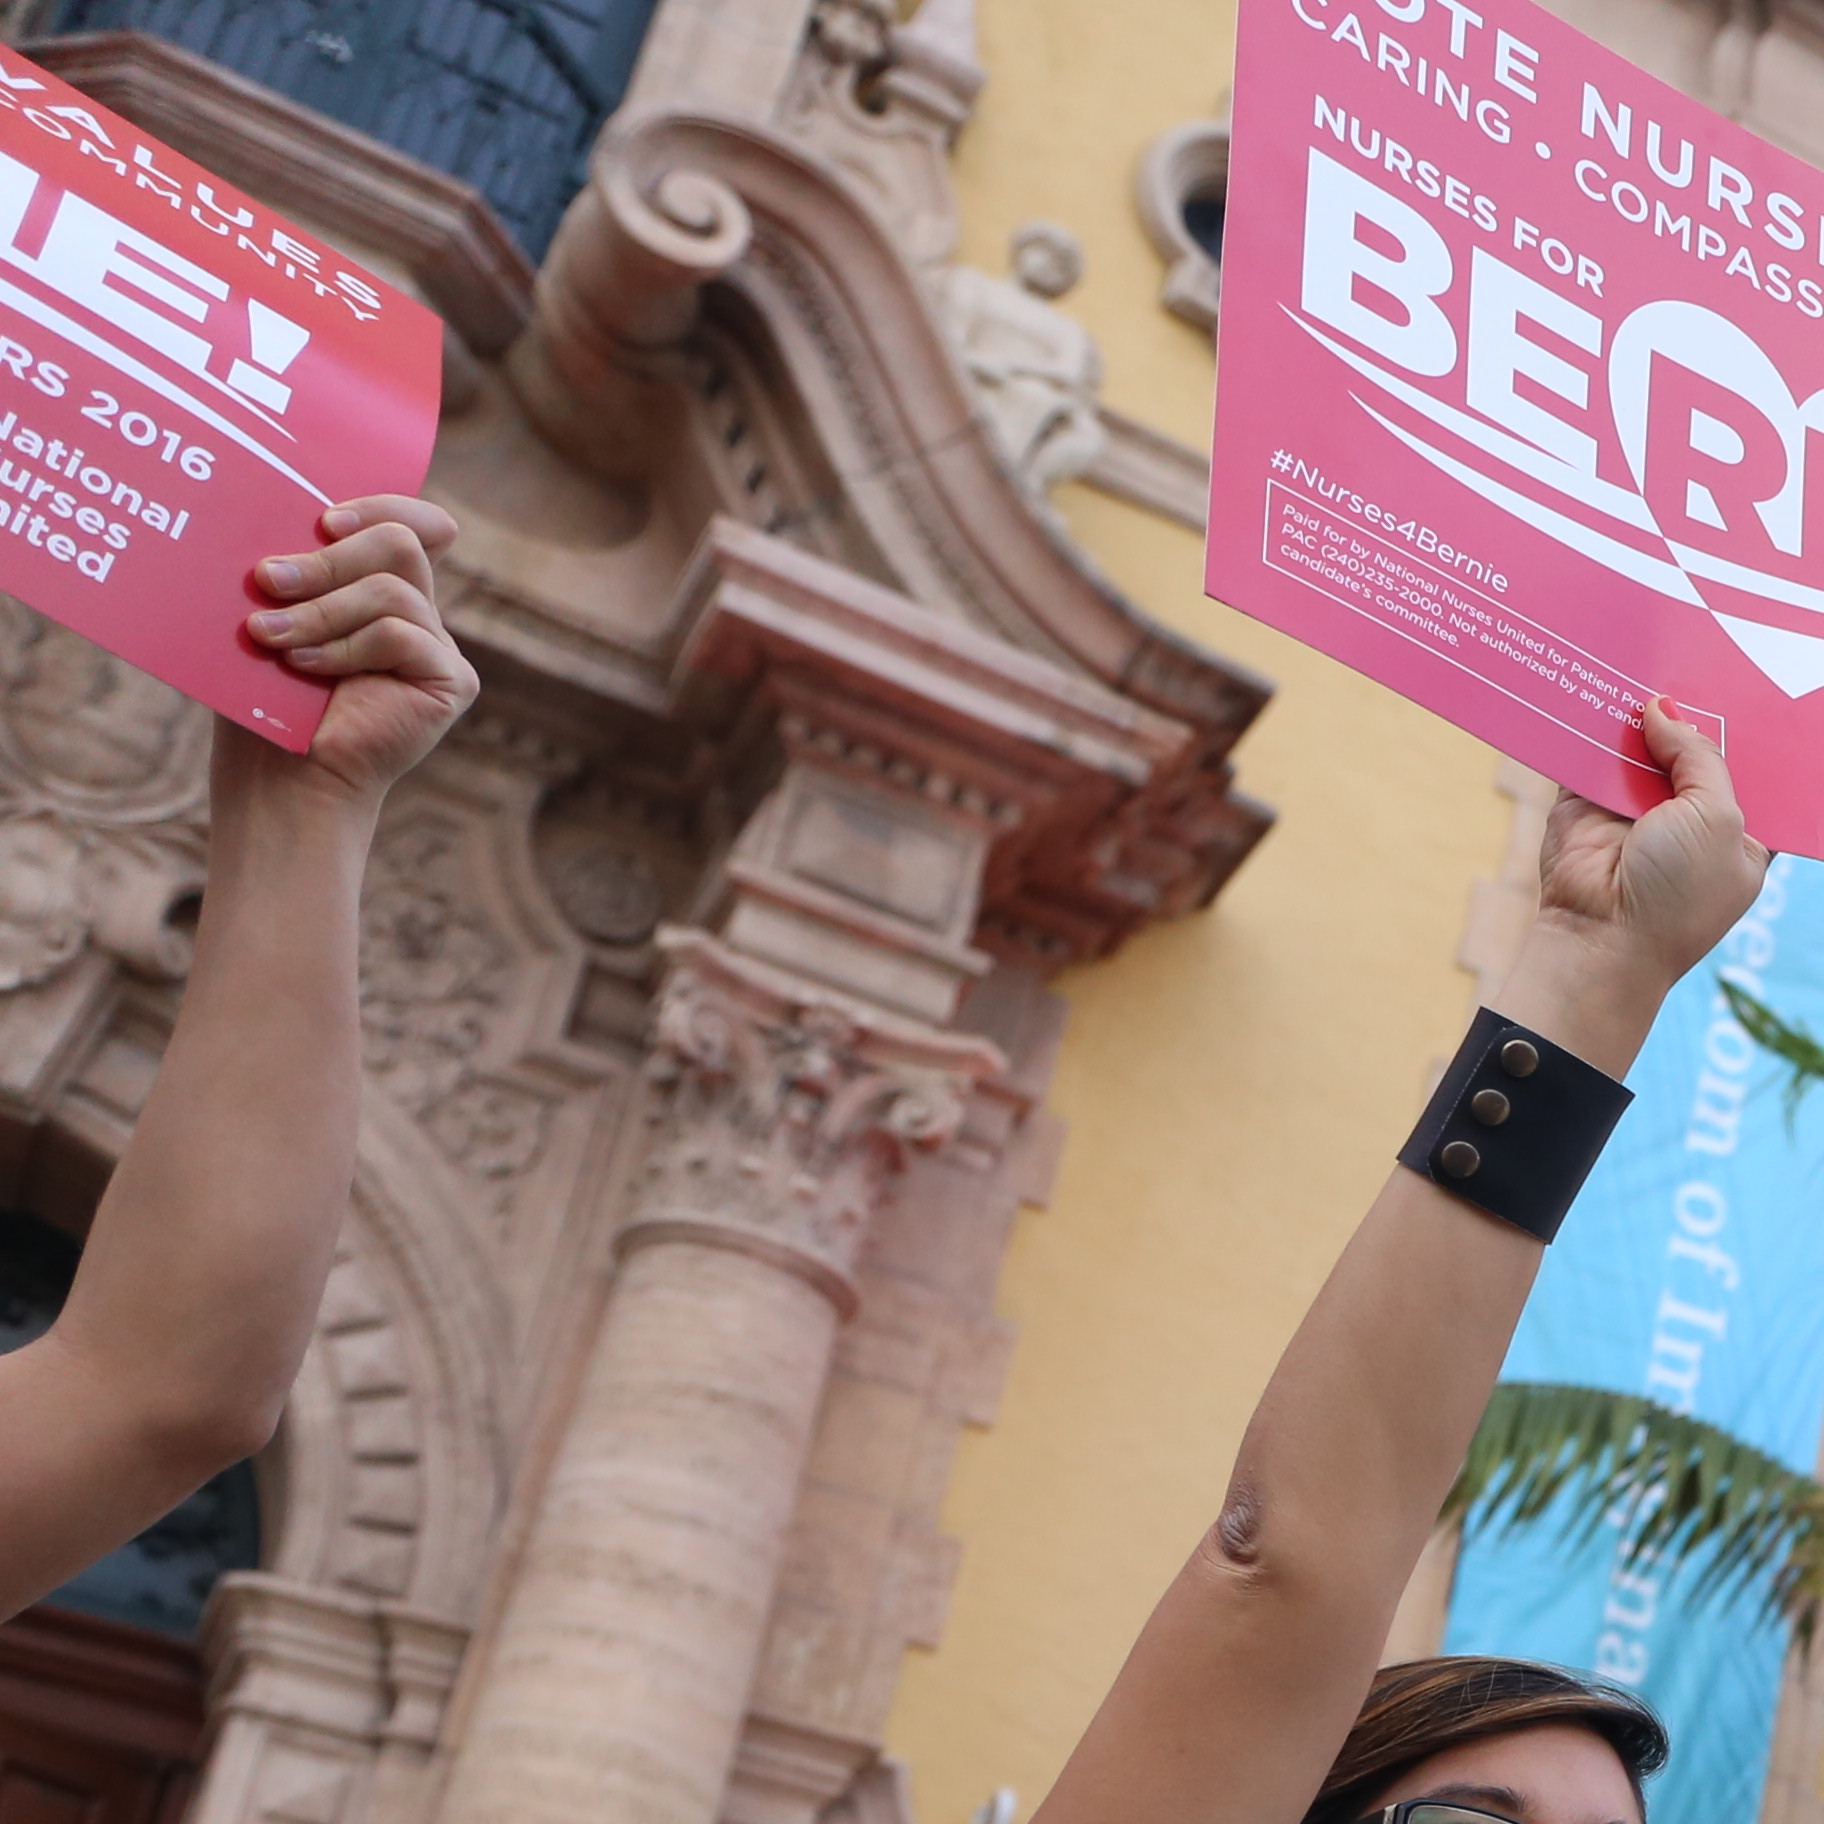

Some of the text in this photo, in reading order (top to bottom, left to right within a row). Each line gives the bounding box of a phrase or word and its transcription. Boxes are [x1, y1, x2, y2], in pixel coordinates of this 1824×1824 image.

[1291, 0, 1512, 145] CARING
[1313, 93, 1605, 298] NURSES FOR
[80, 390, 217, 482] 2016
[0, 457, 132, 551] urses
[0, 498, 116, 584] ited
[1269, 448, 1510, 593] #Nurses4Bernie
[1280, 544, 1460, 648] candidate's committee.
[1281, 522, 1645, 732] PAC (240)235-2000. Not authorized by any cand
[1282, 503, 1647, 714] Paid for by National Nurses United for Patient Pro
[1666, 1180, 1740, 1290] of
